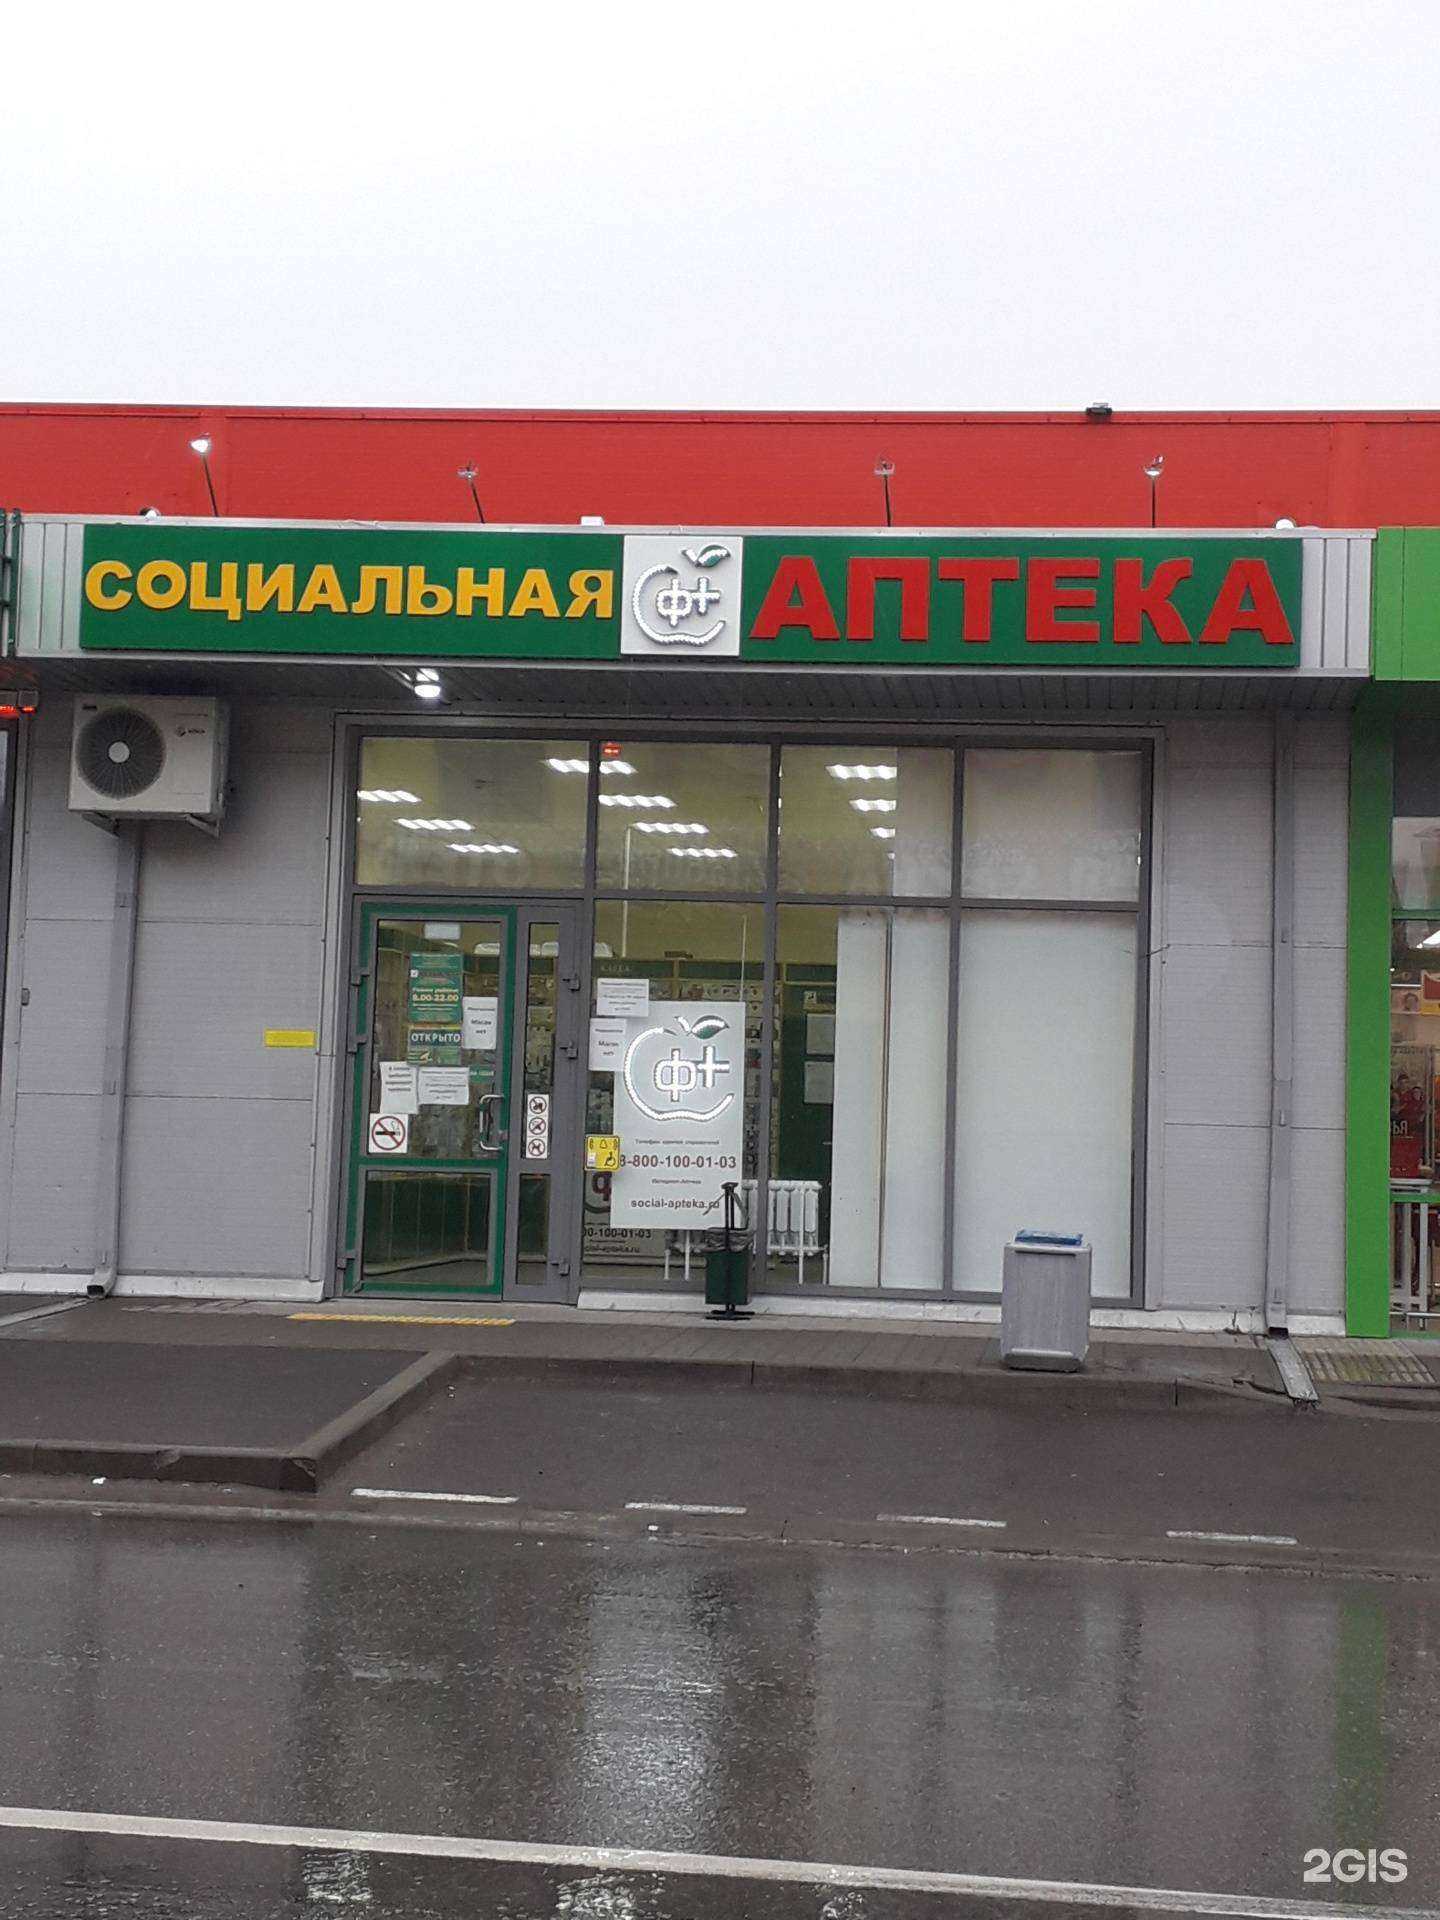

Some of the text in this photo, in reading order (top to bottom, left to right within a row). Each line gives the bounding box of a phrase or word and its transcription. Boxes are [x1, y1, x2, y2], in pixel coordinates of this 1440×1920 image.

[84, 560, 615, 621] СОЦИАЛЬНАЯ
[749, 555, 1296, 644] АПТЕКА
[411, 1033, 461, 1043] ОТКРЫТО
